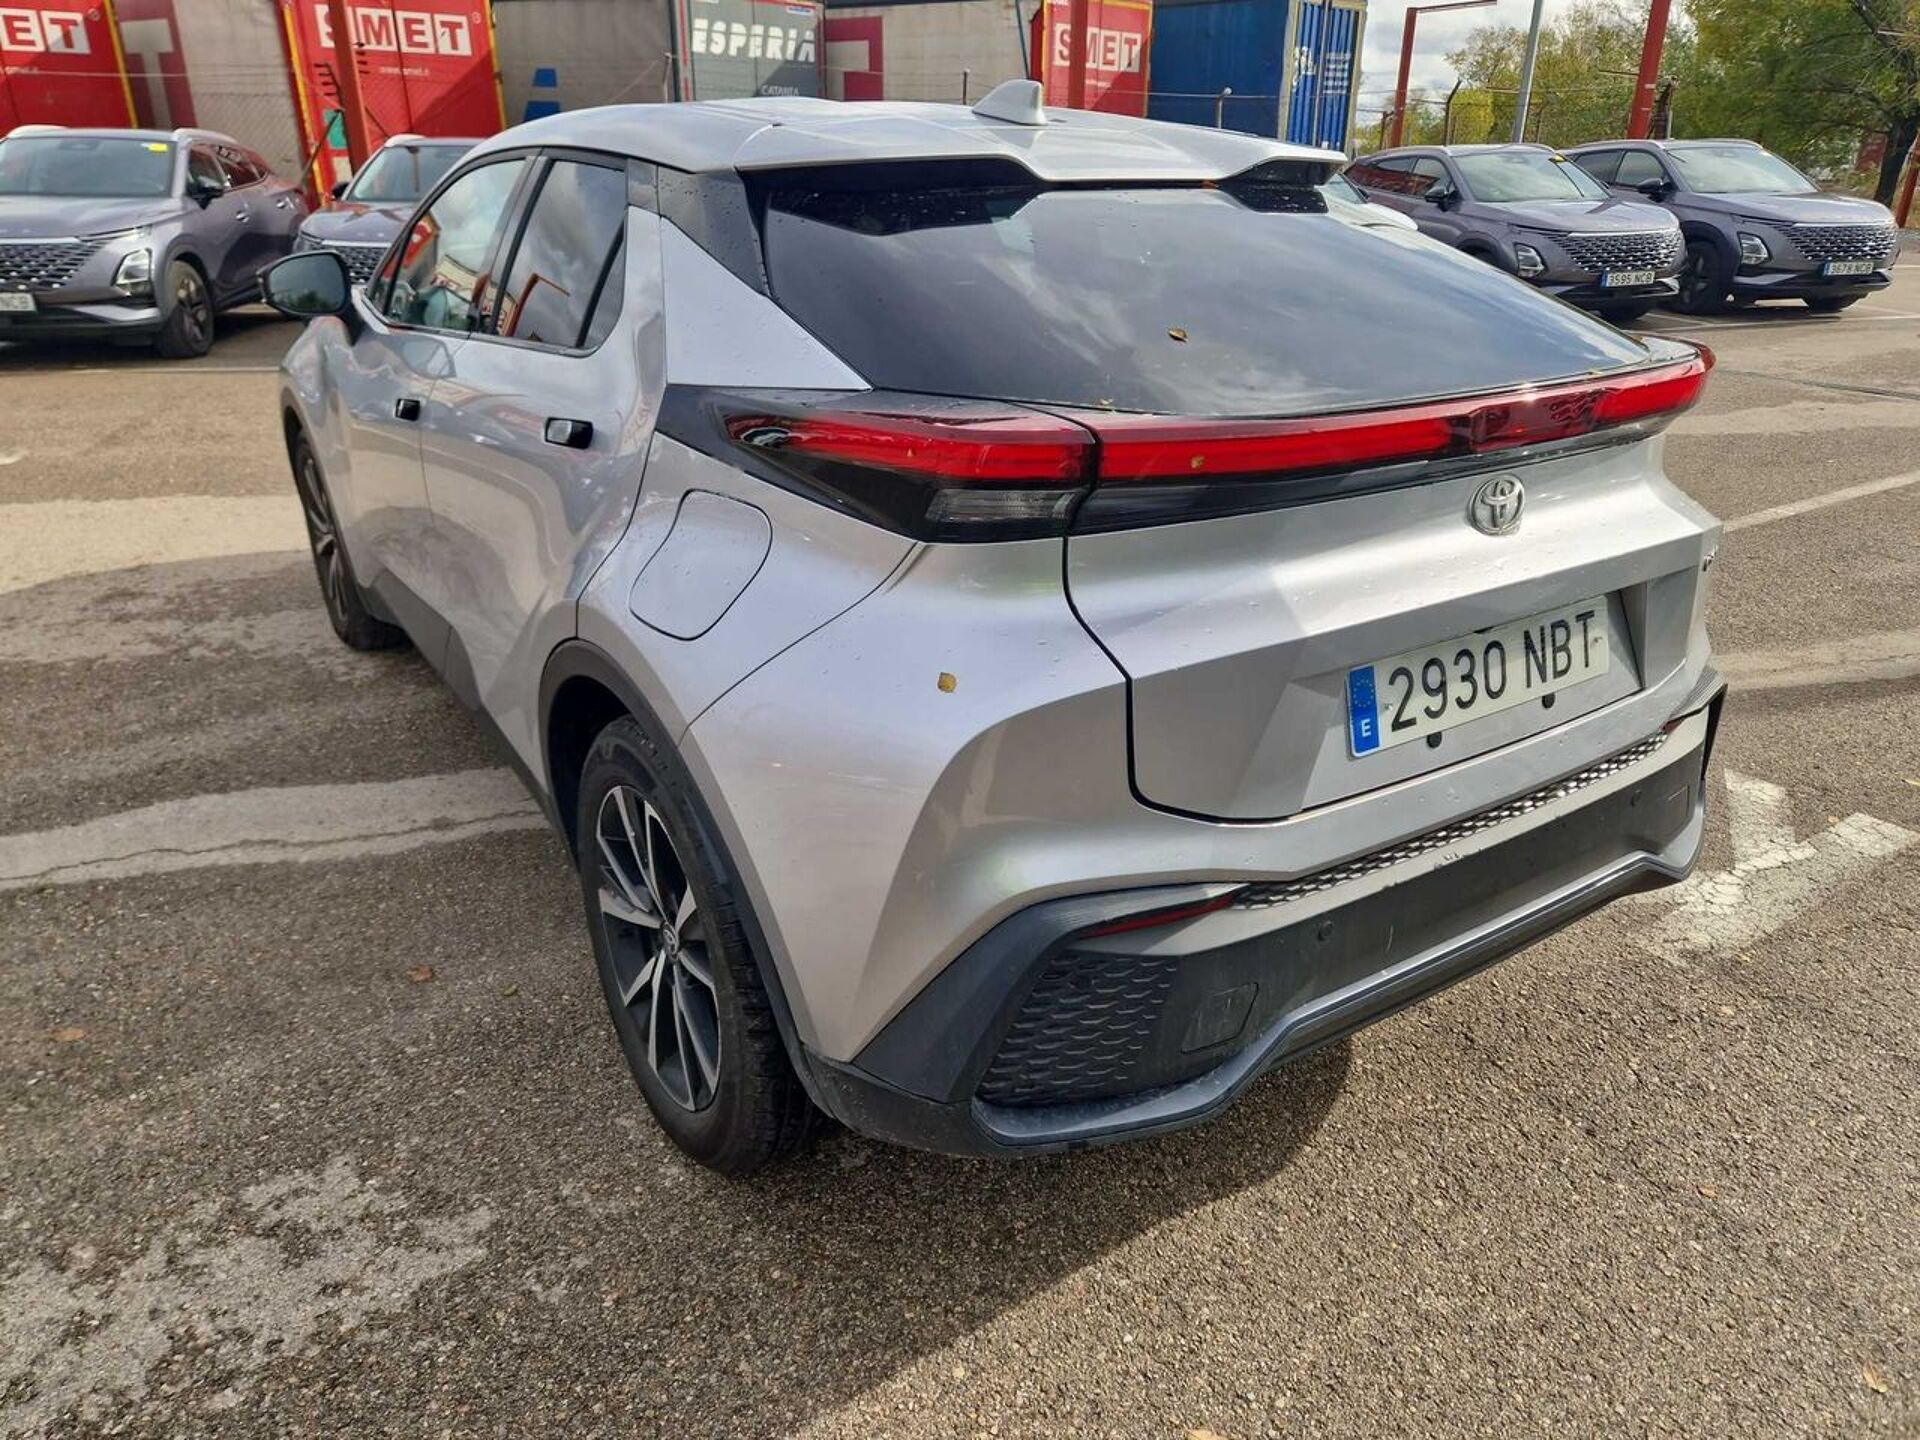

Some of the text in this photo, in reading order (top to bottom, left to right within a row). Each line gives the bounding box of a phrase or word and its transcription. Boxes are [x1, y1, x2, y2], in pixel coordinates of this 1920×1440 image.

[692, 19, 815, 62] ESPERIA
[1388, 609, 1595, 733] 2930 NBT
[1361, 718, 1371, 737] E
